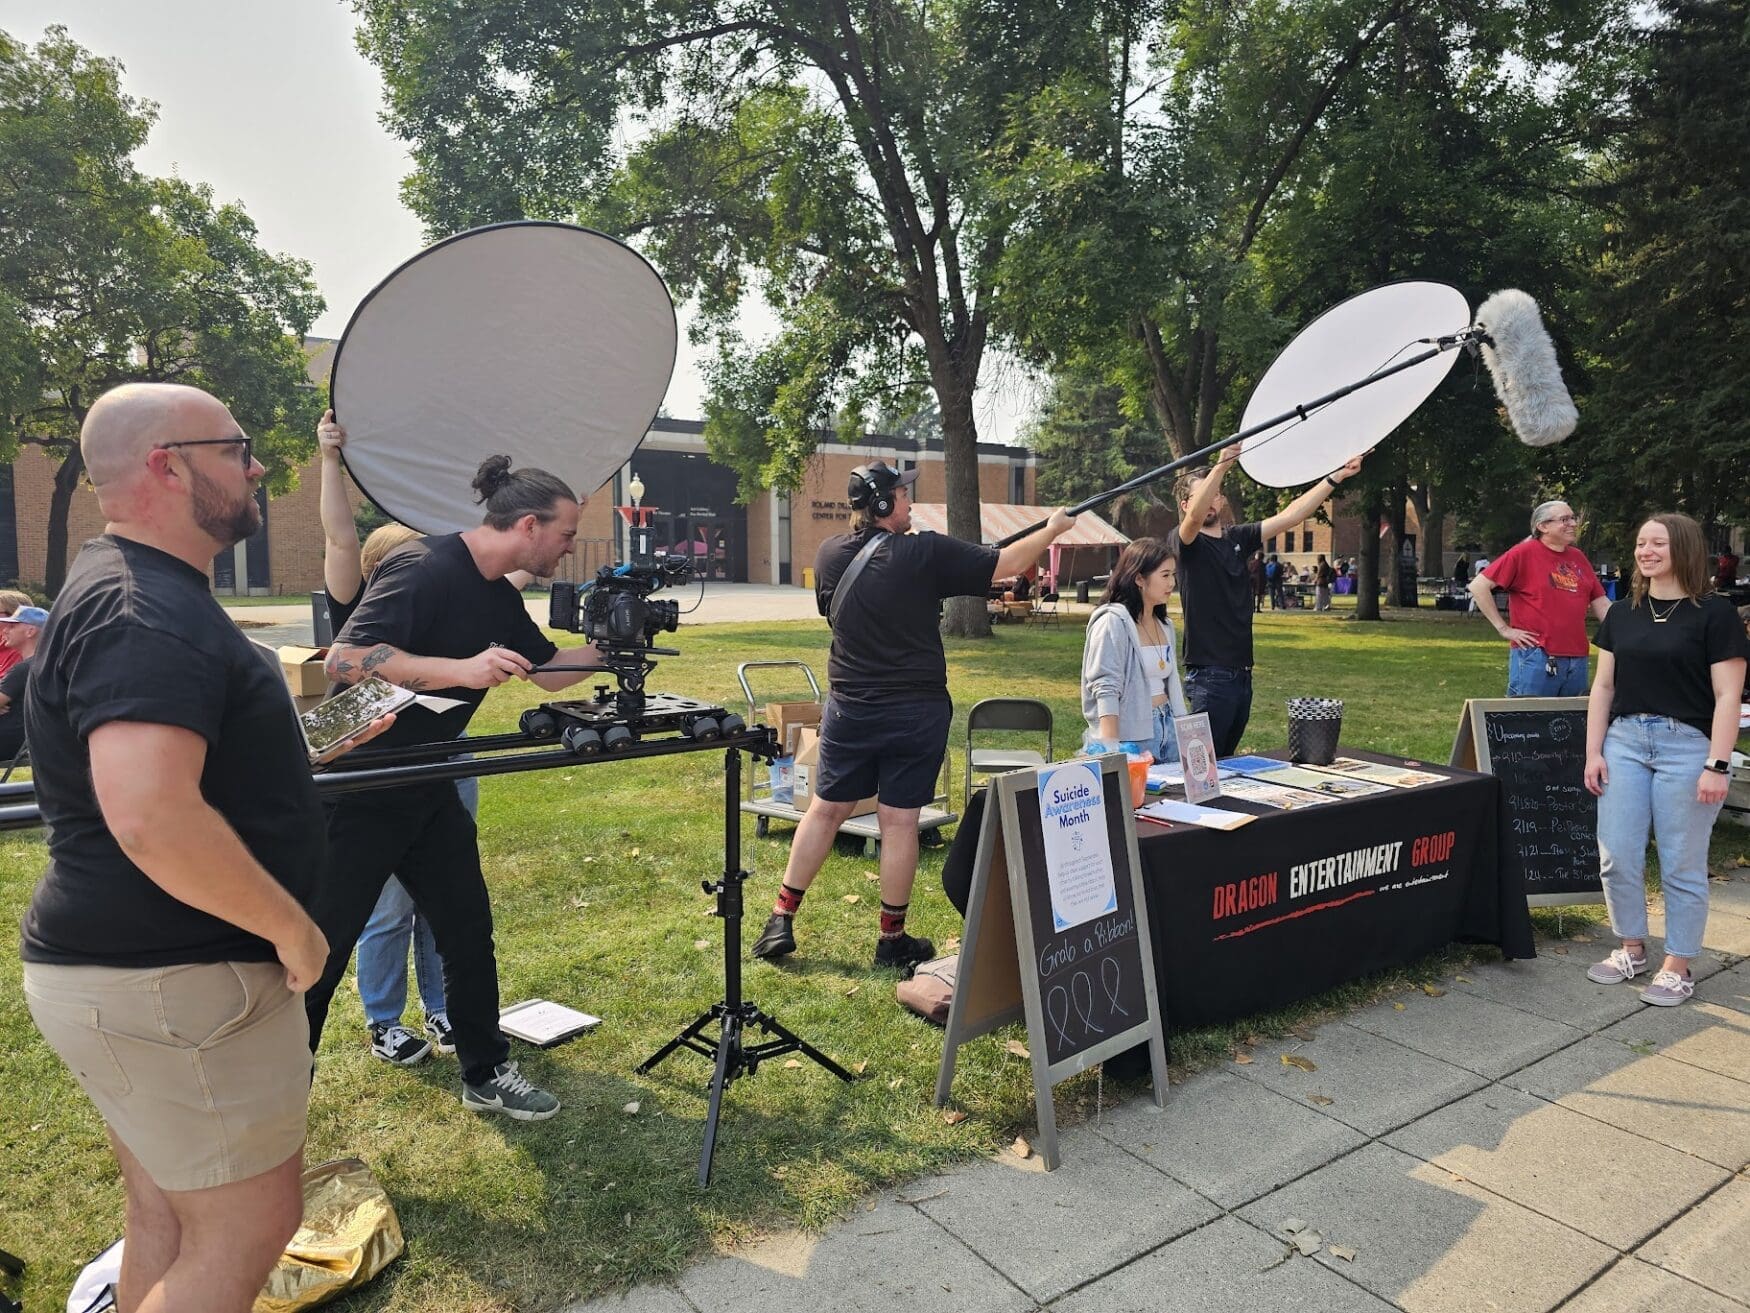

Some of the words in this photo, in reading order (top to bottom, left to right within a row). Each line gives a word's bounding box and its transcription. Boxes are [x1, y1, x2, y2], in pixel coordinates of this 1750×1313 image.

[812, 512, 833, 520] CENTER
[835, 512, 846, 520] FOR
[1053, 784, 1089, 804] Suicide
[1045, 795, 1101, 818] Awareness
[1060, 809, 1089, 828] Month
[1213, 871, 1278, 920] DRAGON
[1290, 841, 1403, 899] ENTERTAINMENT
[1411, 831, 1455, 868] GROUP
[1040, 937, 1076, 976] Grab
[1084, 938, 1094, 953] a
[1095, 909, 1133, 948] Ribbon!
